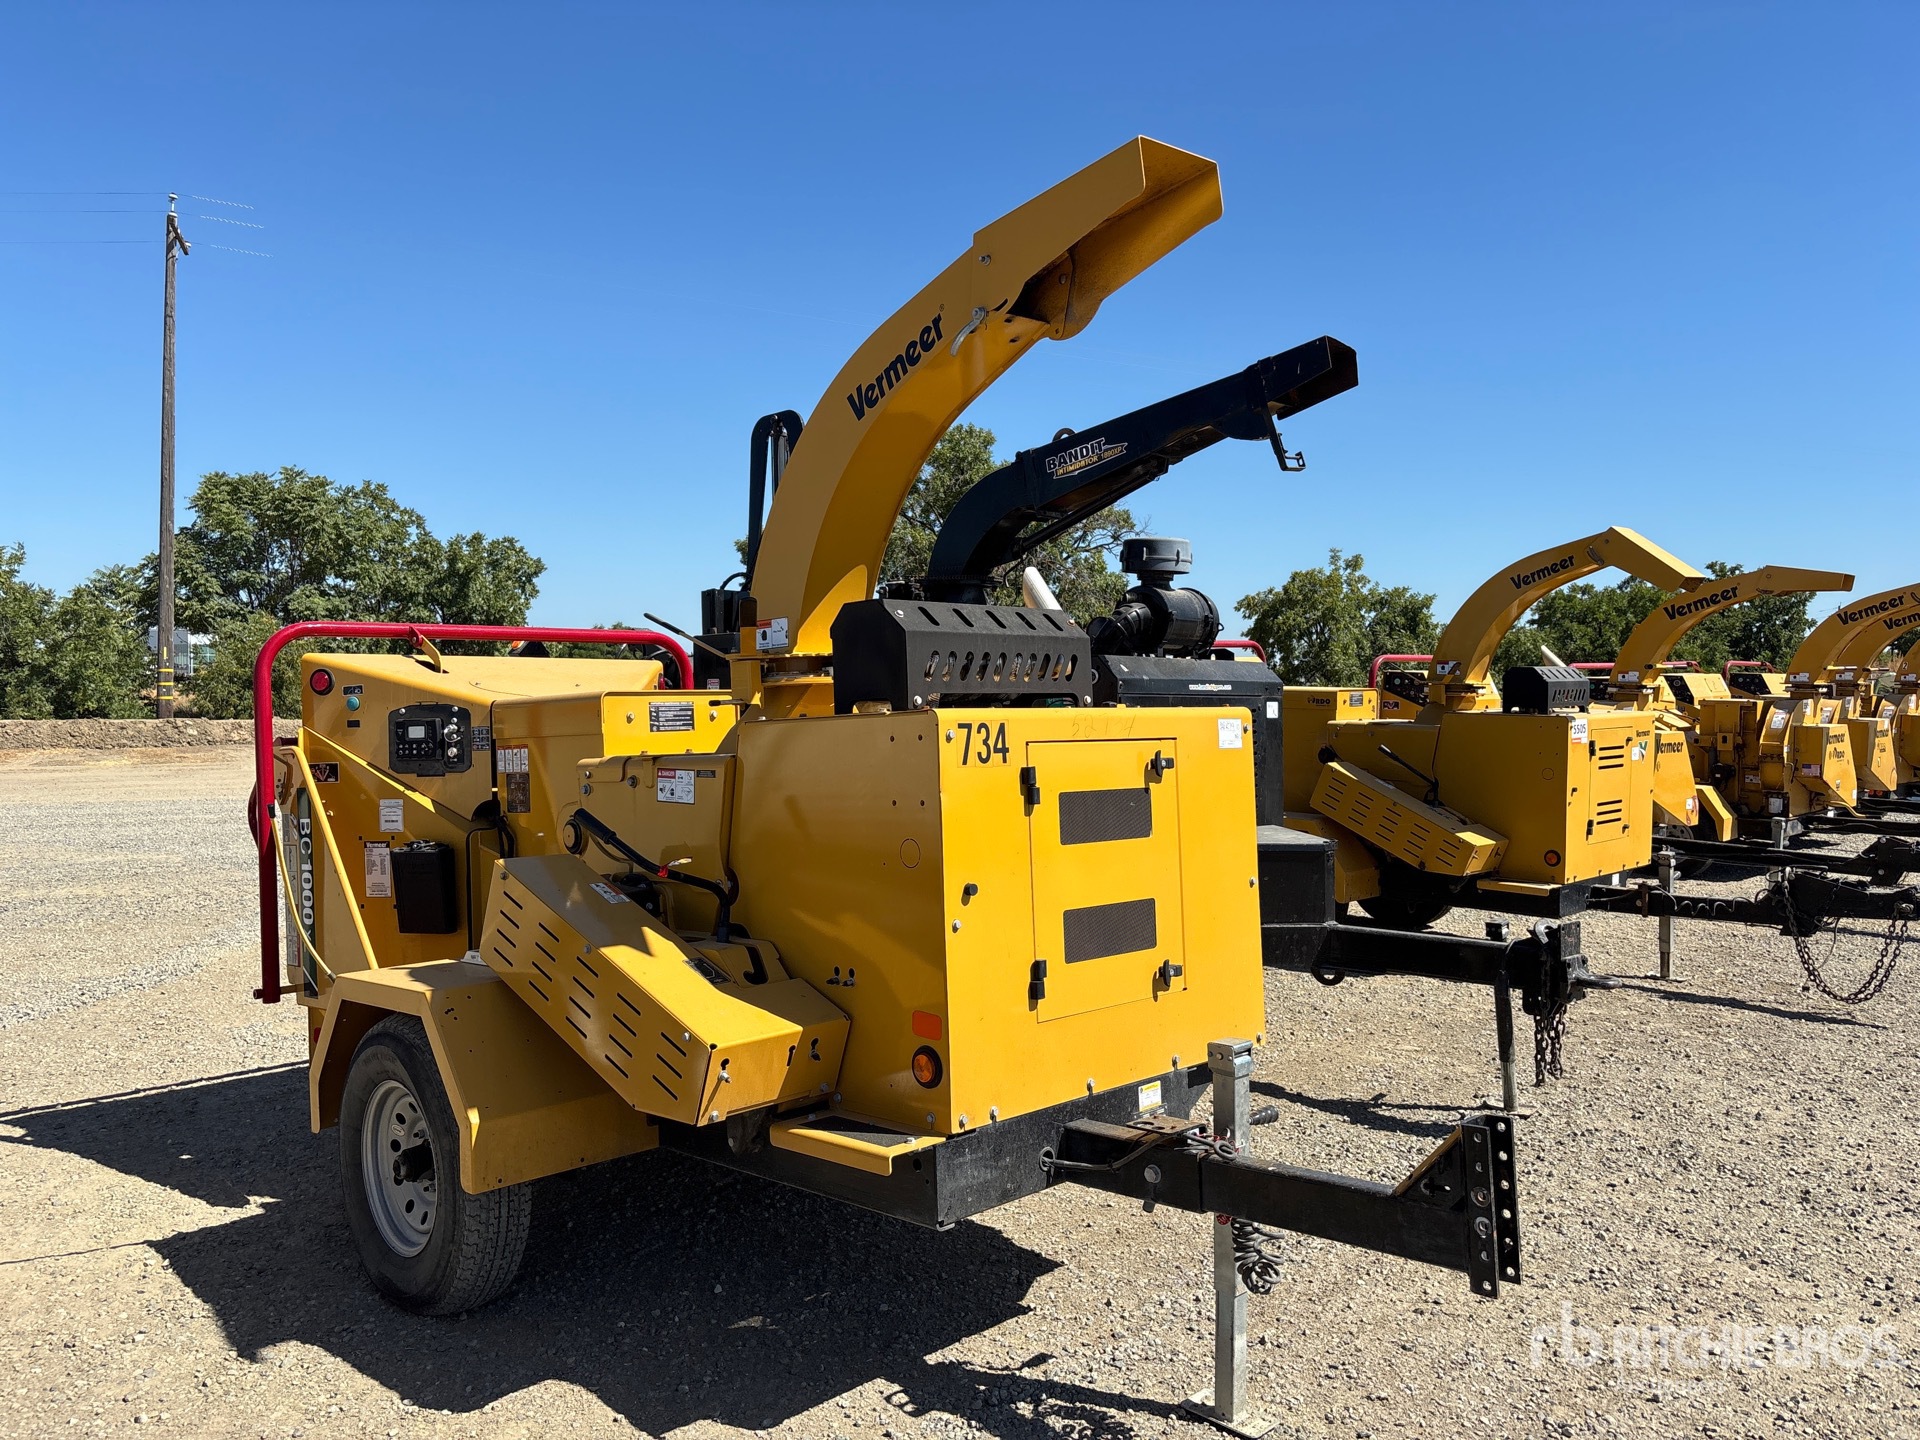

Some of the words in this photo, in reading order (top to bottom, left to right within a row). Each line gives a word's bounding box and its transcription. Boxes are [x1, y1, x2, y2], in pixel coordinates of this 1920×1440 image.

[847, 312, 944, 421] Vermeer
[1045, 437, 1105, 472] BANDIT
[1509, 554, 1575, 590] Vermeer
[1662, 585, 1739, 621] Vermeer
[1836, 594, 1905, 625] Vermeer
[957, 722, 1010, 766] 734
[1573, 723, 1587, 735] 5505
